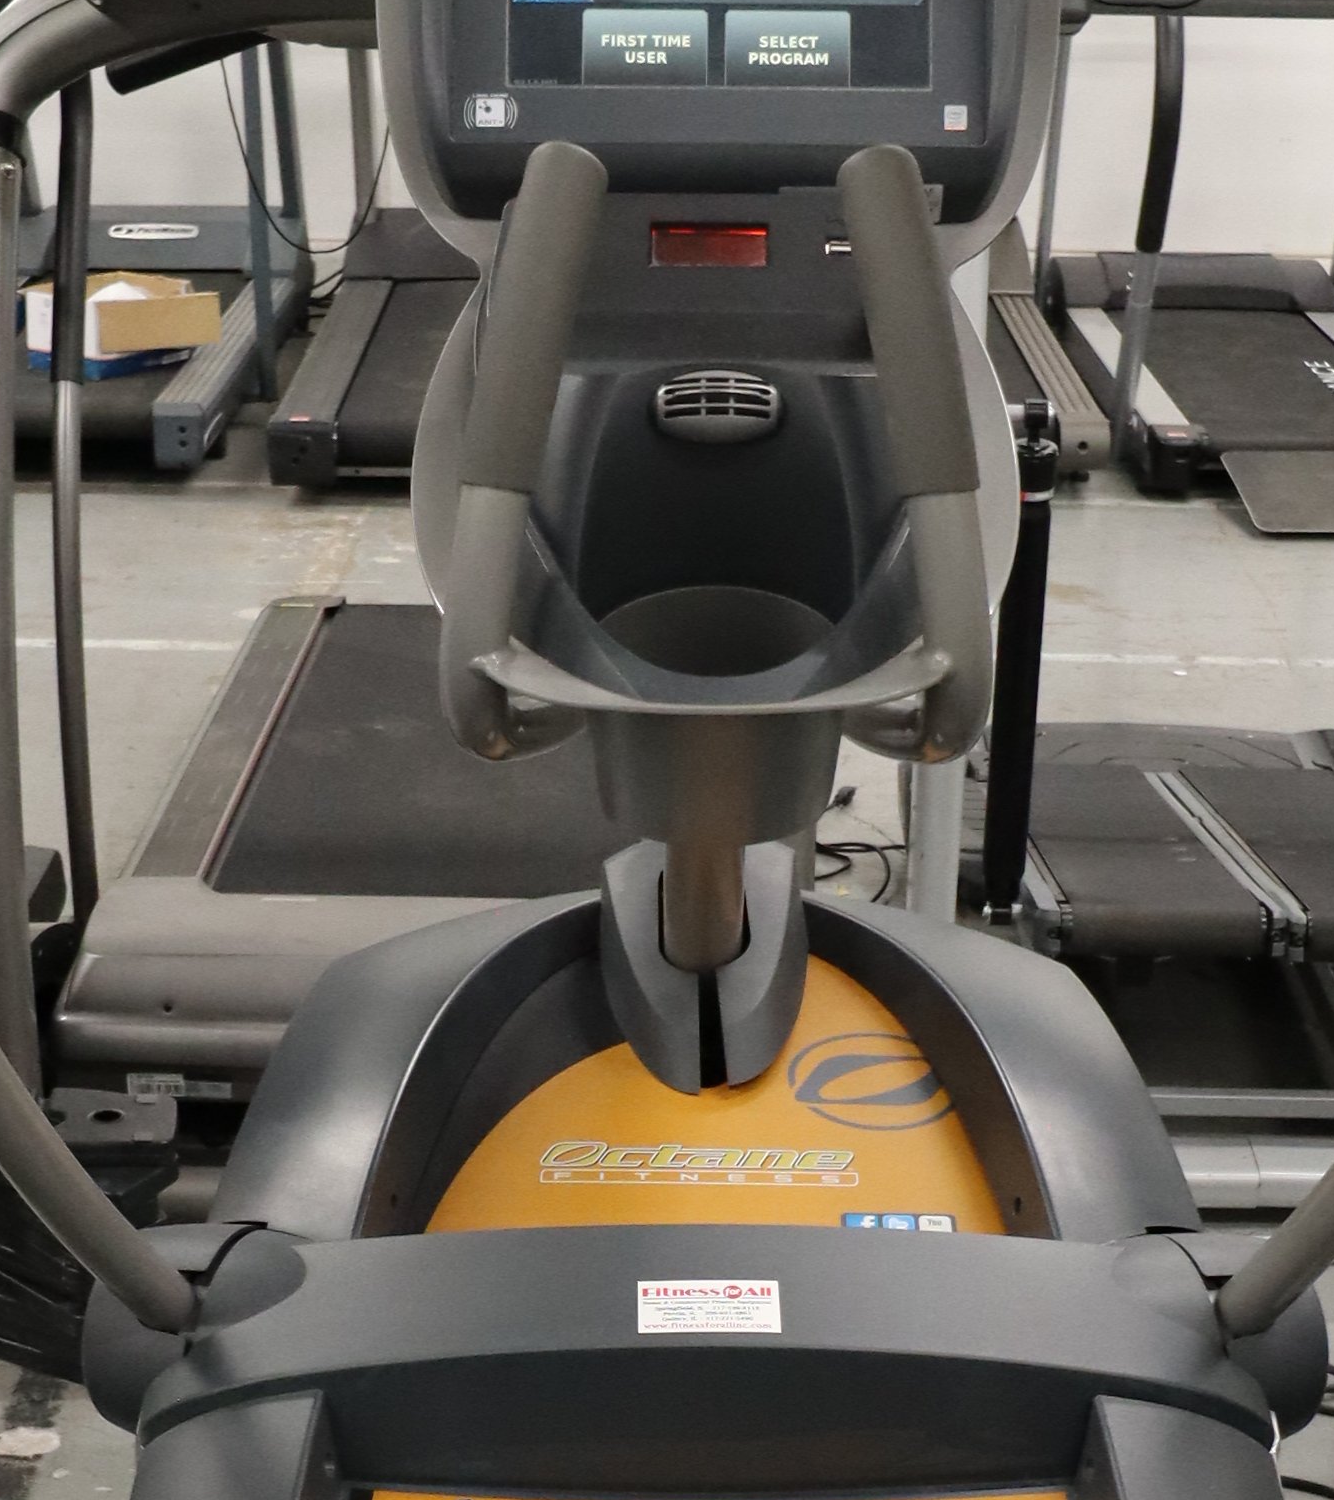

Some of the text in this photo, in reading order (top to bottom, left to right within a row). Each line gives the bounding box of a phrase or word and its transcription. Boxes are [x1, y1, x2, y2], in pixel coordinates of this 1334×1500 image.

[601, 34, 691, 48] FIRST TIME
[758, 35, 819, 49] SELECT
[625, 51, 668, 65] USER
[748, 51, 829, 66] PROGRAM
[540, 1140, 856, 1171] Octane
[553, 1172, 841, 1184] FITNESS
[642, 1286, 772, 1298] Fitness for All
